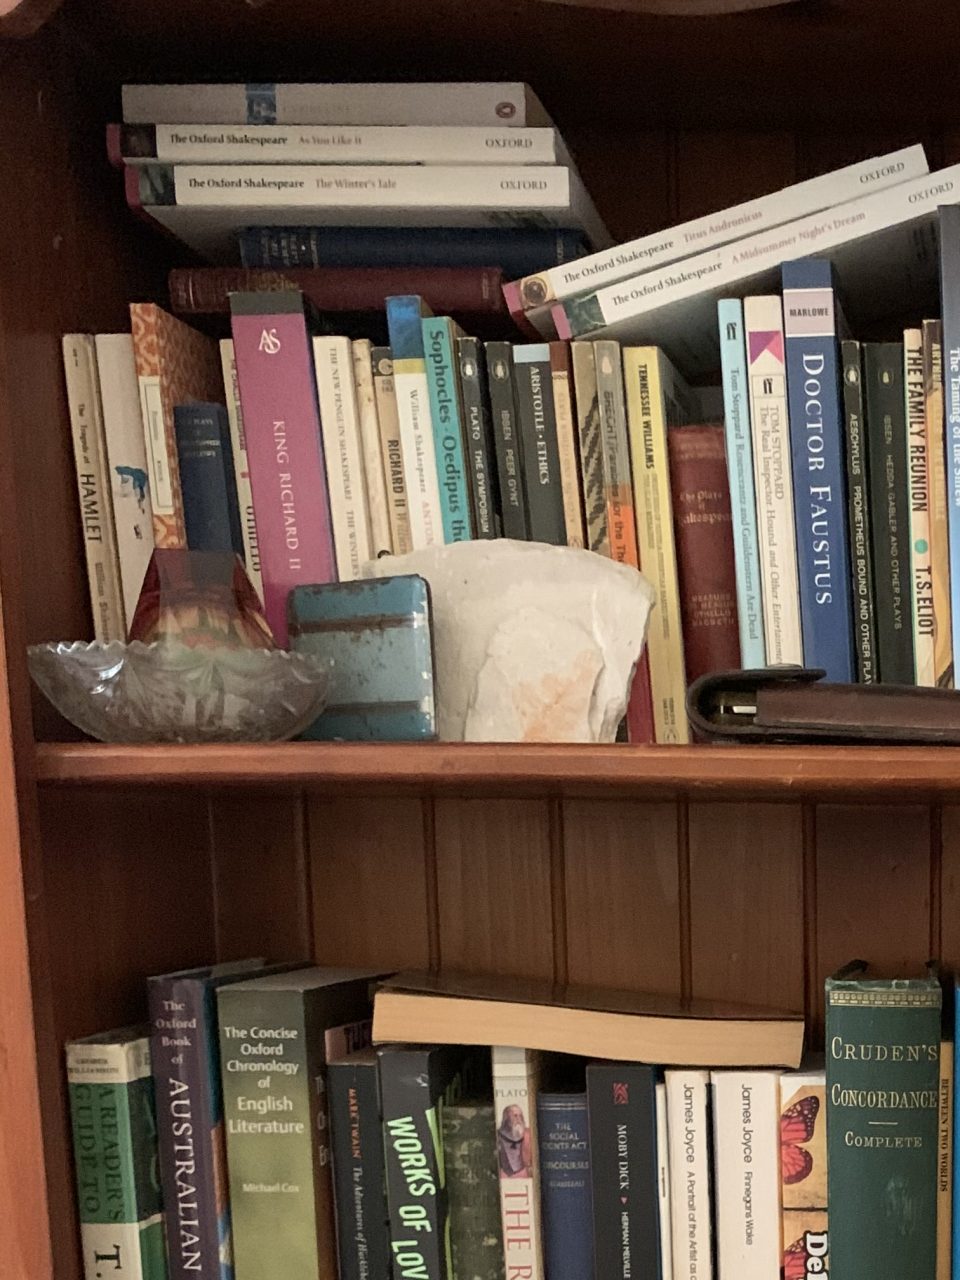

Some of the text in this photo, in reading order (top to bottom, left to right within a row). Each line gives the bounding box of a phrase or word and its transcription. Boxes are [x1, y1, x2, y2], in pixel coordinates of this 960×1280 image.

[485, 137, 533, 150] OXFORD
[500, 180, 547, 192] OXFORD
[860, 162, 905, 184] OXFORD
[908, 181, 954, 204] OXFORD
[564, 210, 763, 284] The Oxford Shakespeare Titus Andronicus
[789, 308, 830, 317] MARLOWE
[430, 329, 462, 514] Sophocles Oedipus
[529, 366, 552, 486] ARISTOTLE ETHICS
[638, 364, 656, 471] TENNESSEE WILLIAMS
[801, 352, 833, 606] DOCTOR FAUSTUS
[79, 473, 103, 544] HAMLET
[272, 420, 302, 571] KING RICHARD II
[224, 1026, 299, 1040] The Concise
[240, 1042, 284, 1056] Oxford
[831, 1036, 939, 1062] CRUDEN'S
[226, 1060, 299, 1075] Chronology
[257, 1076, 271, 1089] of
[236, 1095, 293, 1114] English
[831, 1083, 938, 1109] CONCORDANCE
[228, 1118, 304, 1134] Literature
[845, 1130, 923, 1149] COMPLETE
[387, 1114, 437, 1197] WORKS
[740, 1083, 755, 1245] James Joyce Finnegans Wake
[167, 1076, 203, 1270] AUSTRALIAN
[399, 1202, 433, 1232] OF
[503, 1184, 532, 1249] THE
